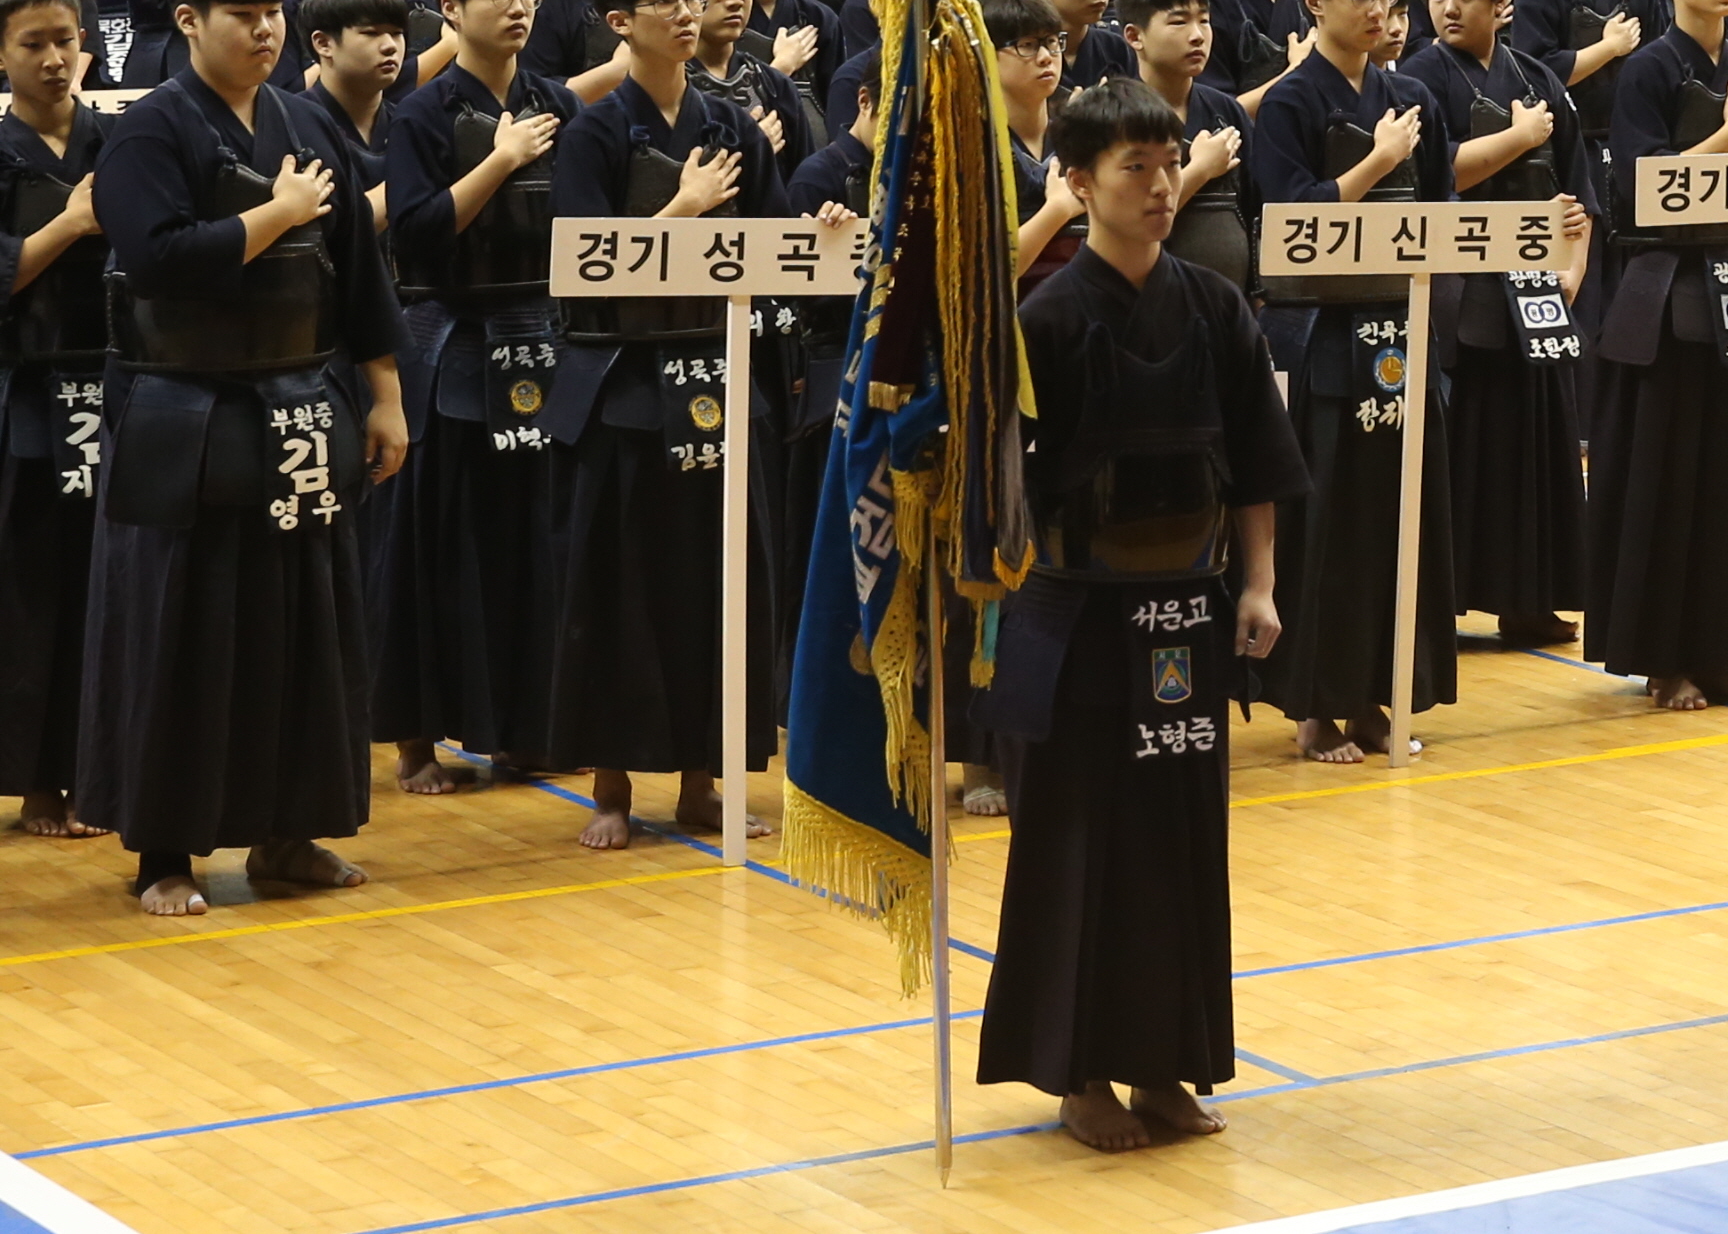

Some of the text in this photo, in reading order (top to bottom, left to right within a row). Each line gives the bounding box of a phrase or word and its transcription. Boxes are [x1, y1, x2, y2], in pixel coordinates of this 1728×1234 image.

[576, 229, 670, 282] 경기
[1283, 217, 1362, 264] 경기
[270, 401, 333, 436] 부원중
[278, 431, 330, 495] 김
[1132, 595, 1213, 633] 서운고
